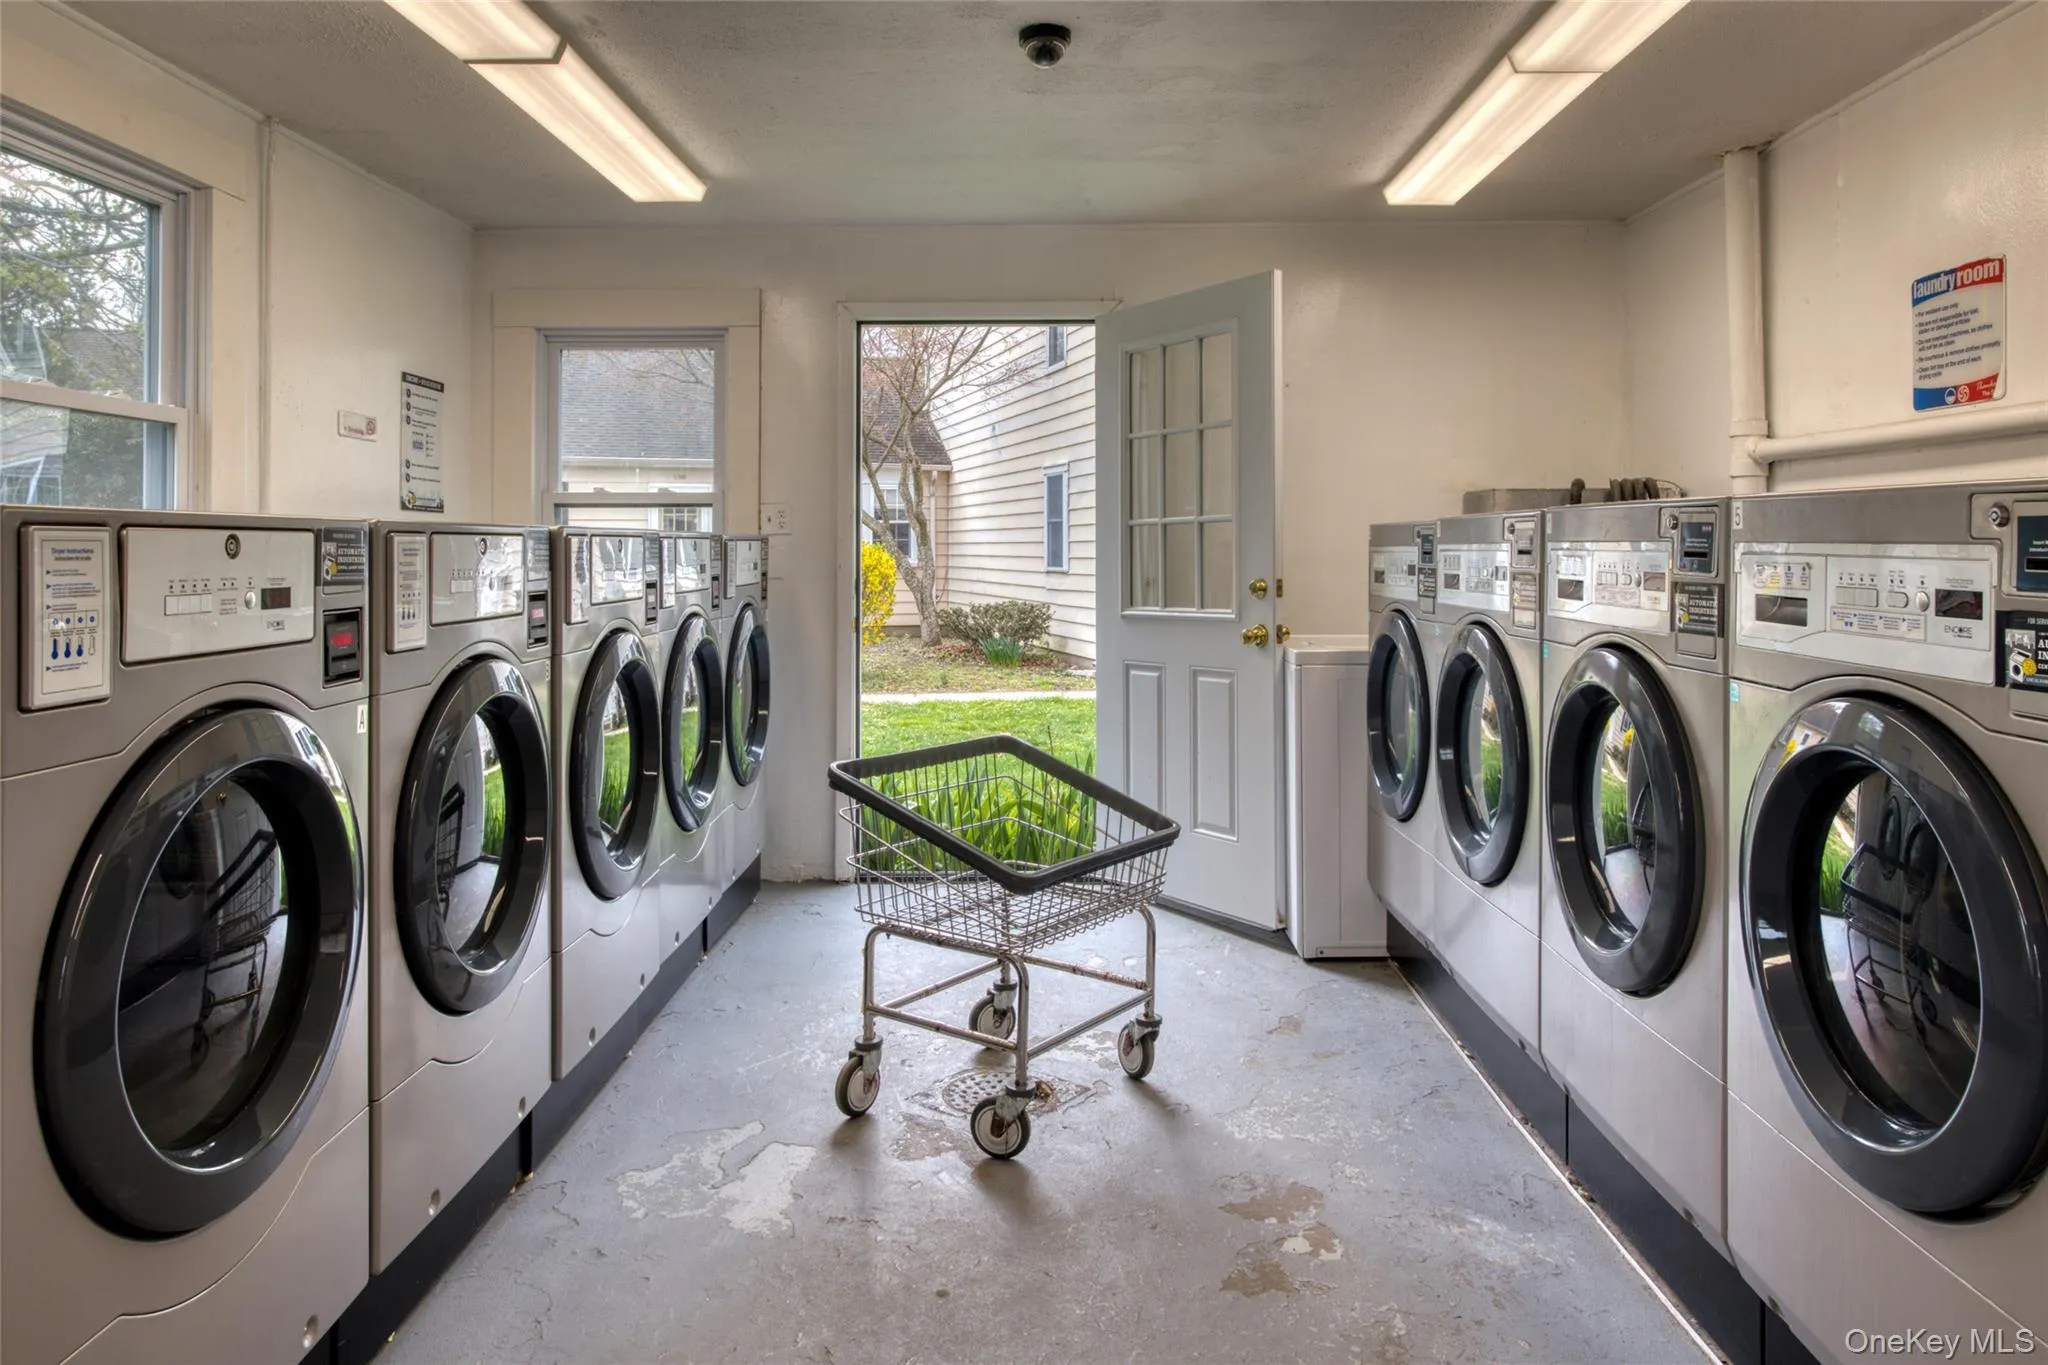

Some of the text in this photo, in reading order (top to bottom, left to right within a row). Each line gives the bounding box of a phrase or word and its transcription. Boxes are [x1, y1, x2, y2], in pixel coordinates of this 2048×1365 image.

[1913, 259, 2000, 299] laundry room
[1735, 506, 1741, 526] 5
